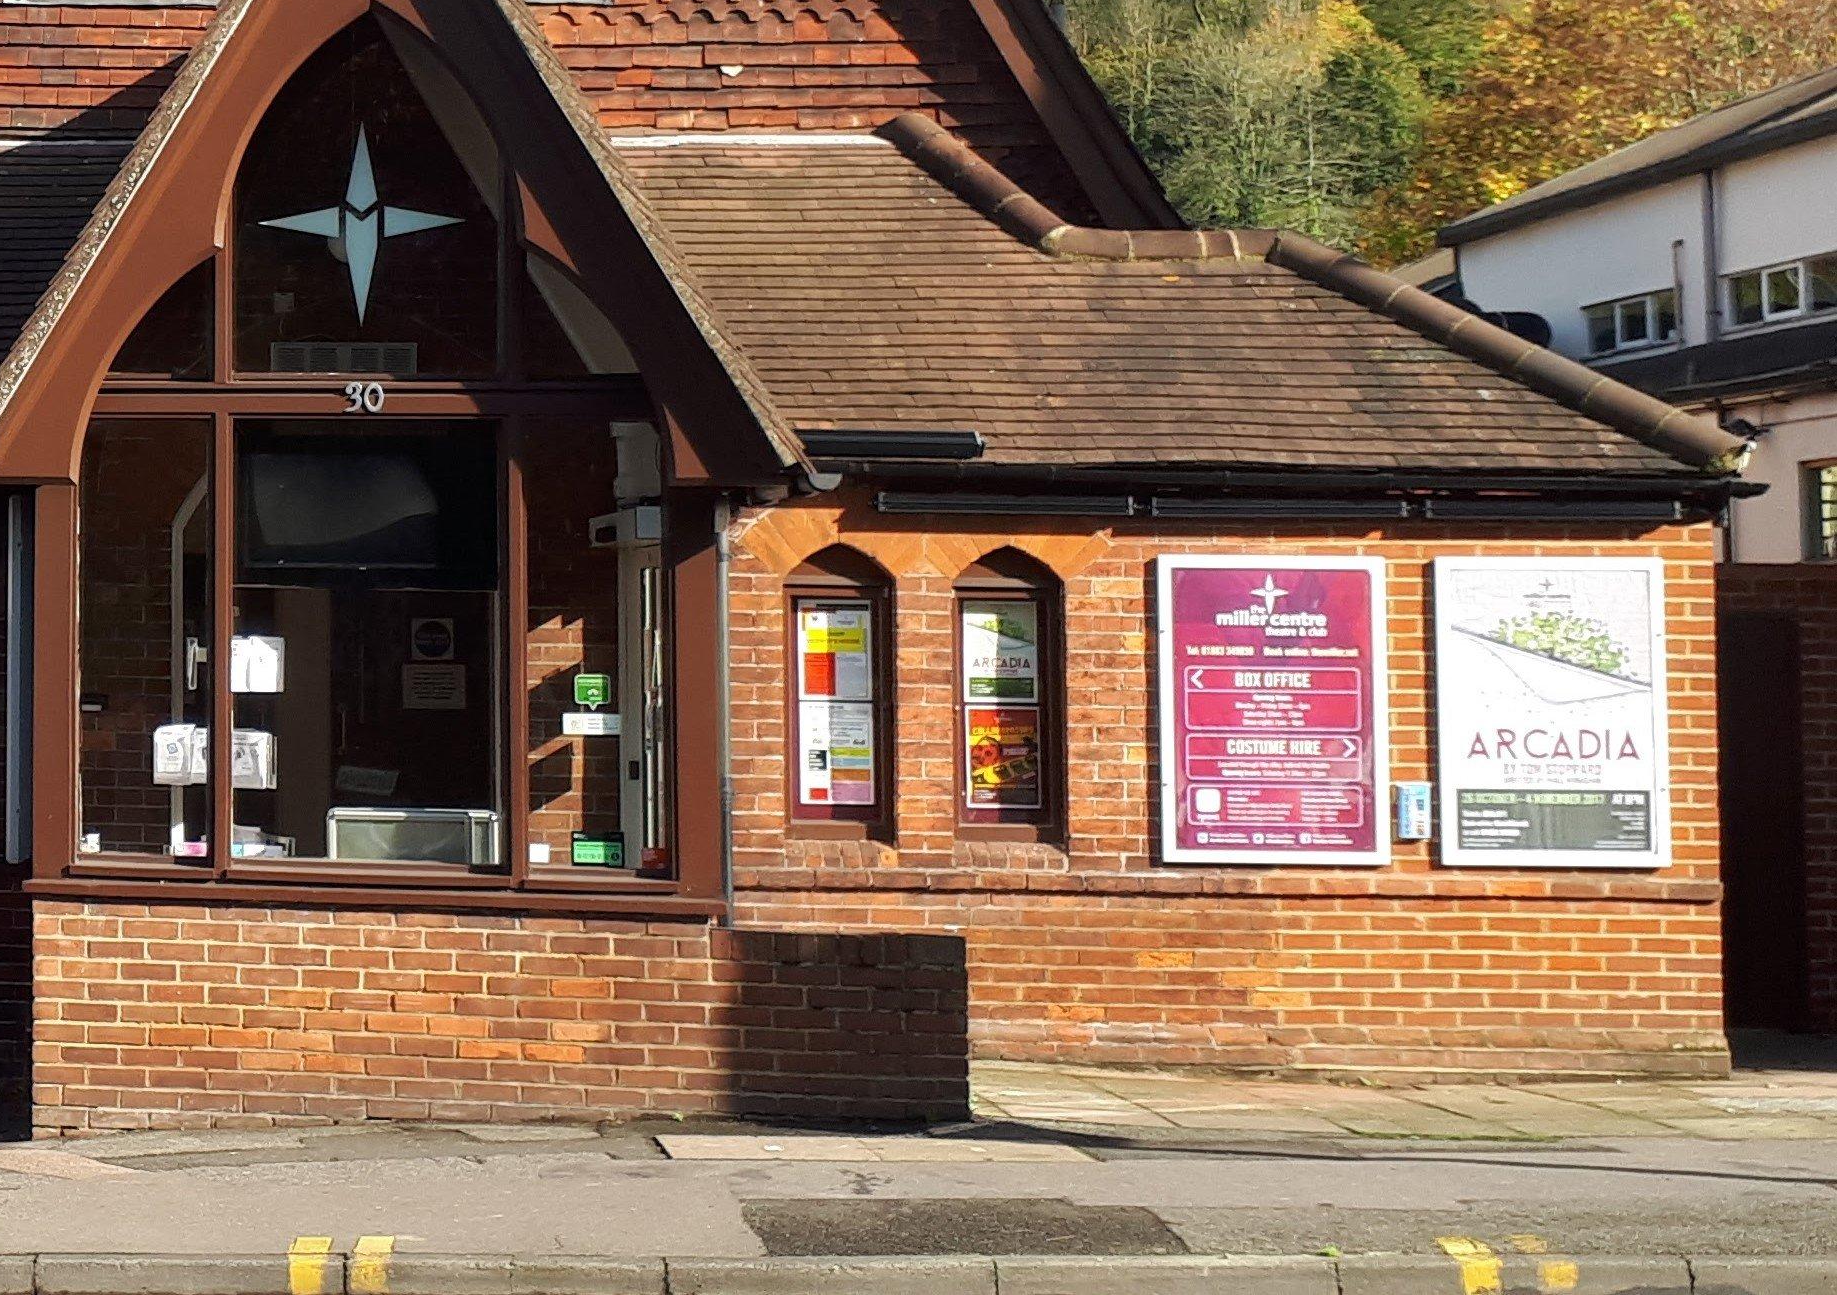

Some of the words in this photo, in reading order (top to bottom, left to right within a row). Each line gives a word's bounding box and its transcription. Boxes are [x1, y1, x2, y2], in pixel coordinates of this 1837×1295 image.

[344, 382, 384, 412] 30
[1216, 609, 1268, 627] miller
[1269, 612, 1327, 627] centre
[972, 656, 1031, 669] ARCADIA
[1235, 672, 1262, 688] BOX
[1264, 672, 1311, 688] OFFICE
[1227, 739, 1288, 755] COSTUME
[1289, 740, 1322, 755] HIRE
[1467, 728, 1641, 760] ARCADIA
